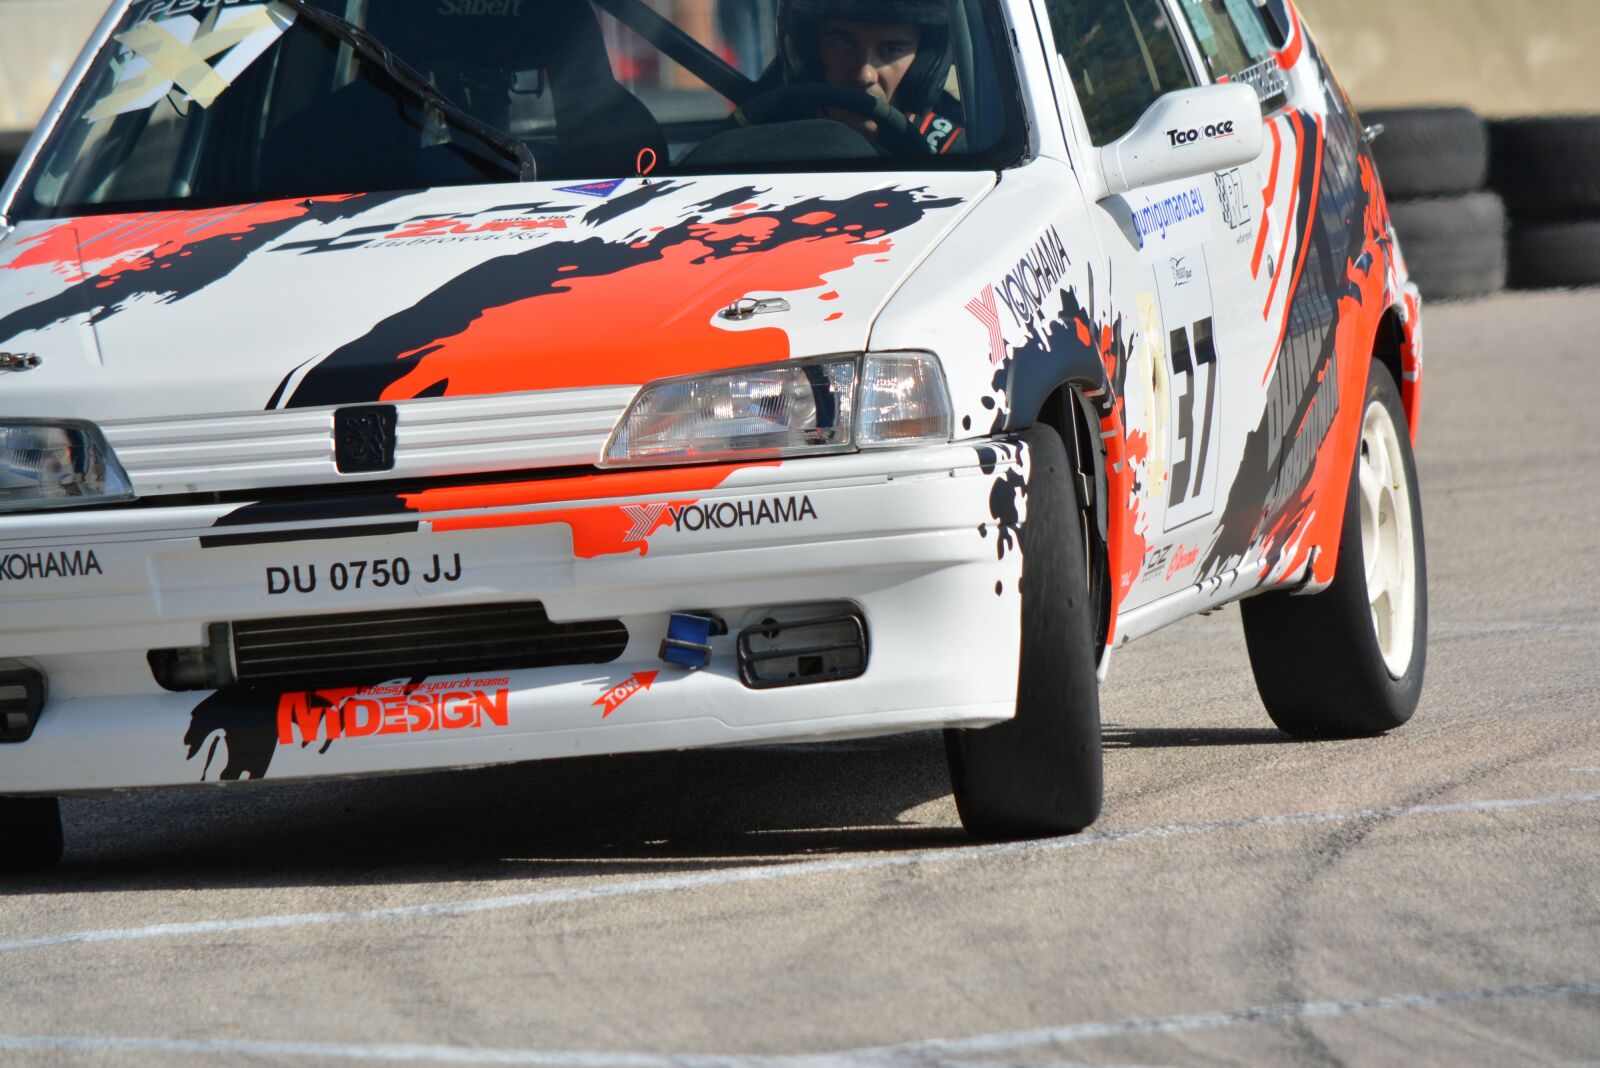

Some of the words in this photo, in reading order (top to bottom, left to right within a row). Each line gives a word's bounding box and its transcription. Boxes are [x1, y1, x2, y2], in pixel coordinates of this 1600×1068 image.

[994, 223, 1072, 329] YOKOHAMA
[1167, 315, 1217, 509] 37
[668, 495, 818, 532] YOKOHAMA
[0, 549, 103, 580] KOHAMA
[266, 564, 317, 595] DU
[330, 556, 410, 591] 0750
[422, 553, 462, 583] JJ
[604, 678, 639, 706] TOW
